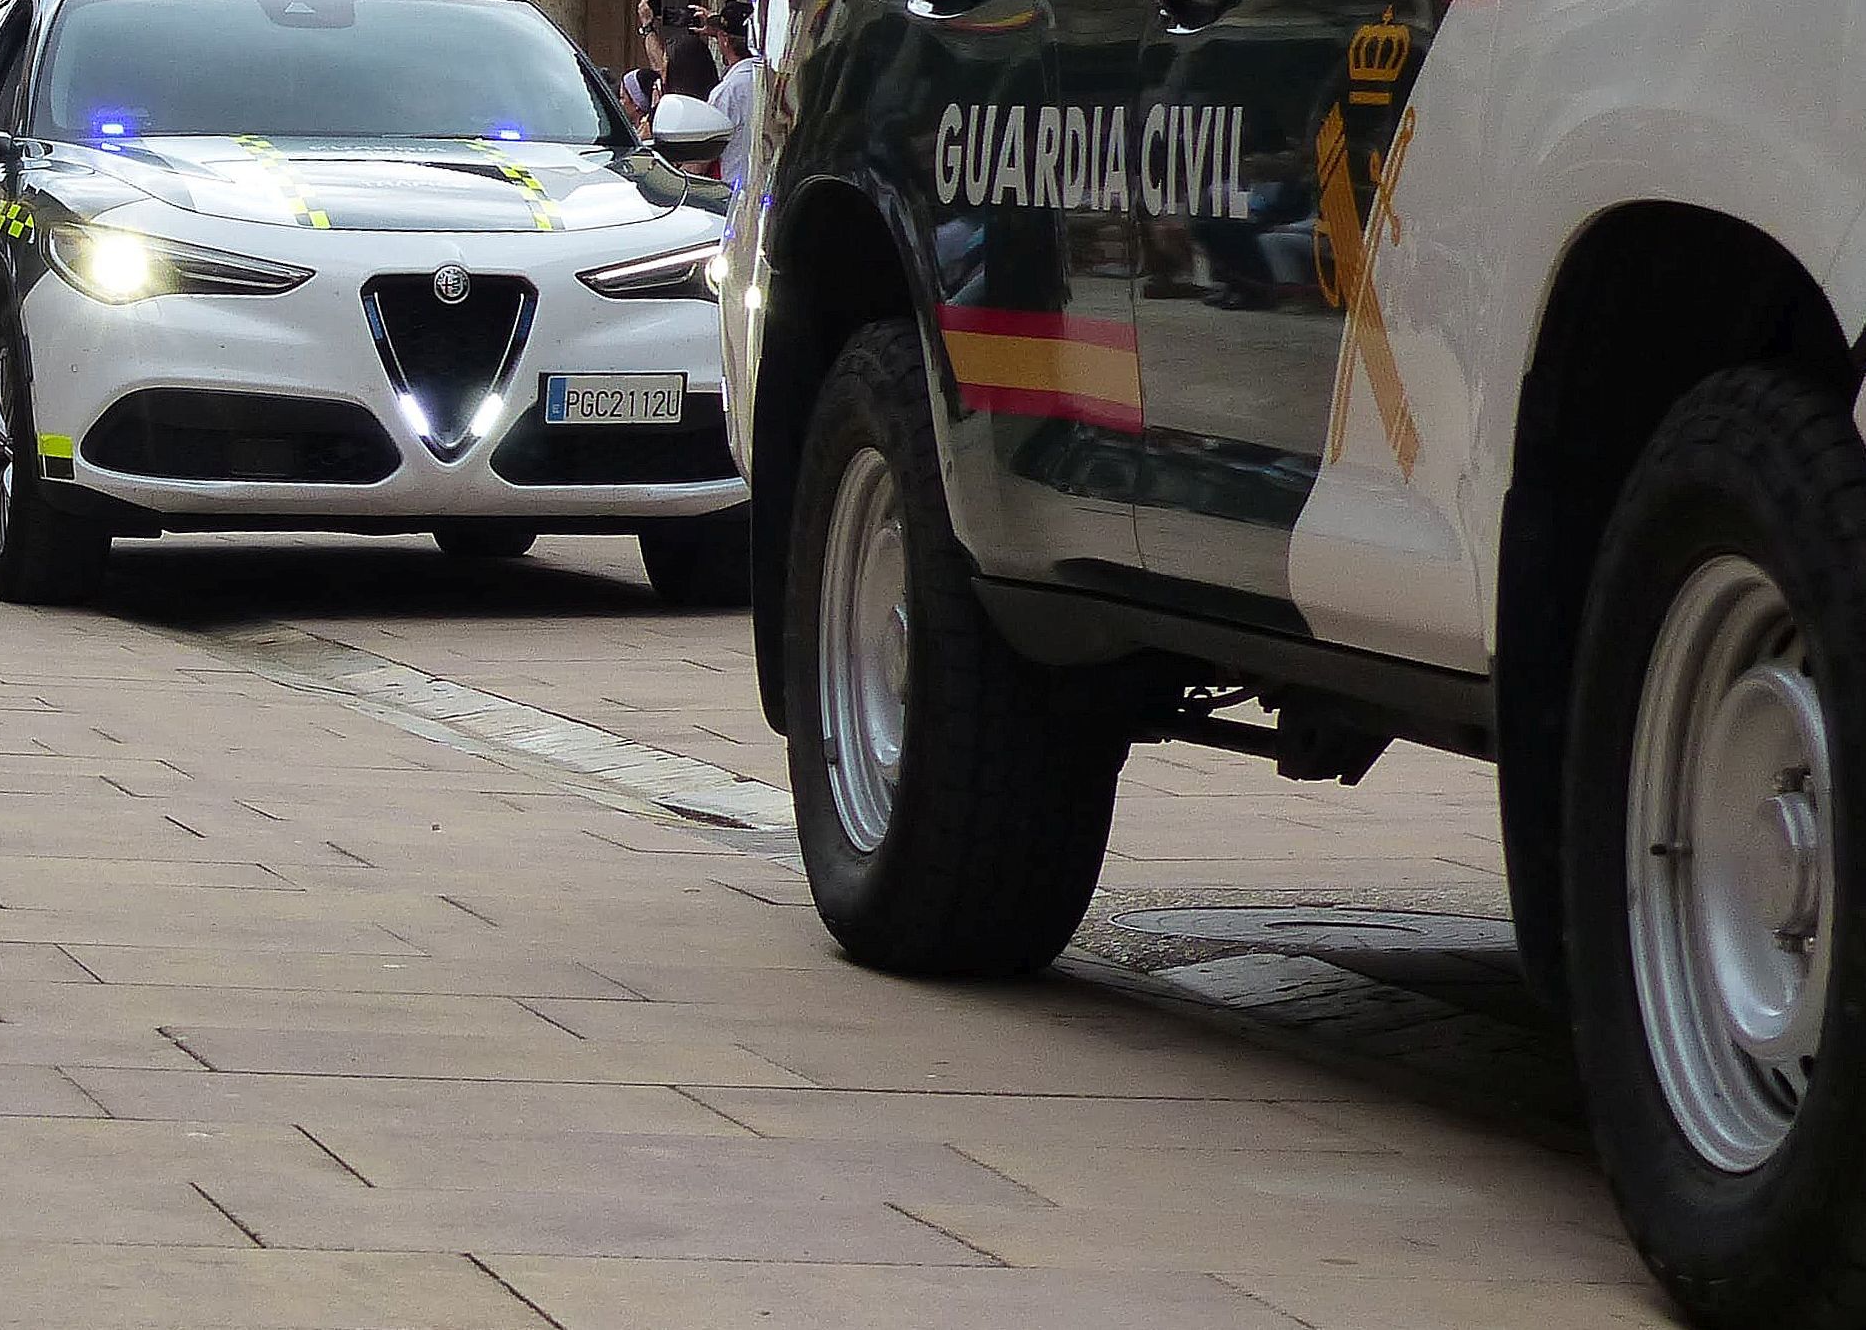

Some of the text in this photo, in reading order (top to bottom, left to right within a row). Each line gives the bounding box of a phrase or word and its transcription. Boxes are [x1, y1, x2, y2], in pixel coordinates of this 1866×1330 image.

[935, 103, 1248, 220] GUARDIA CIVIL
[566, 390, 680, 418] PGC2112U
